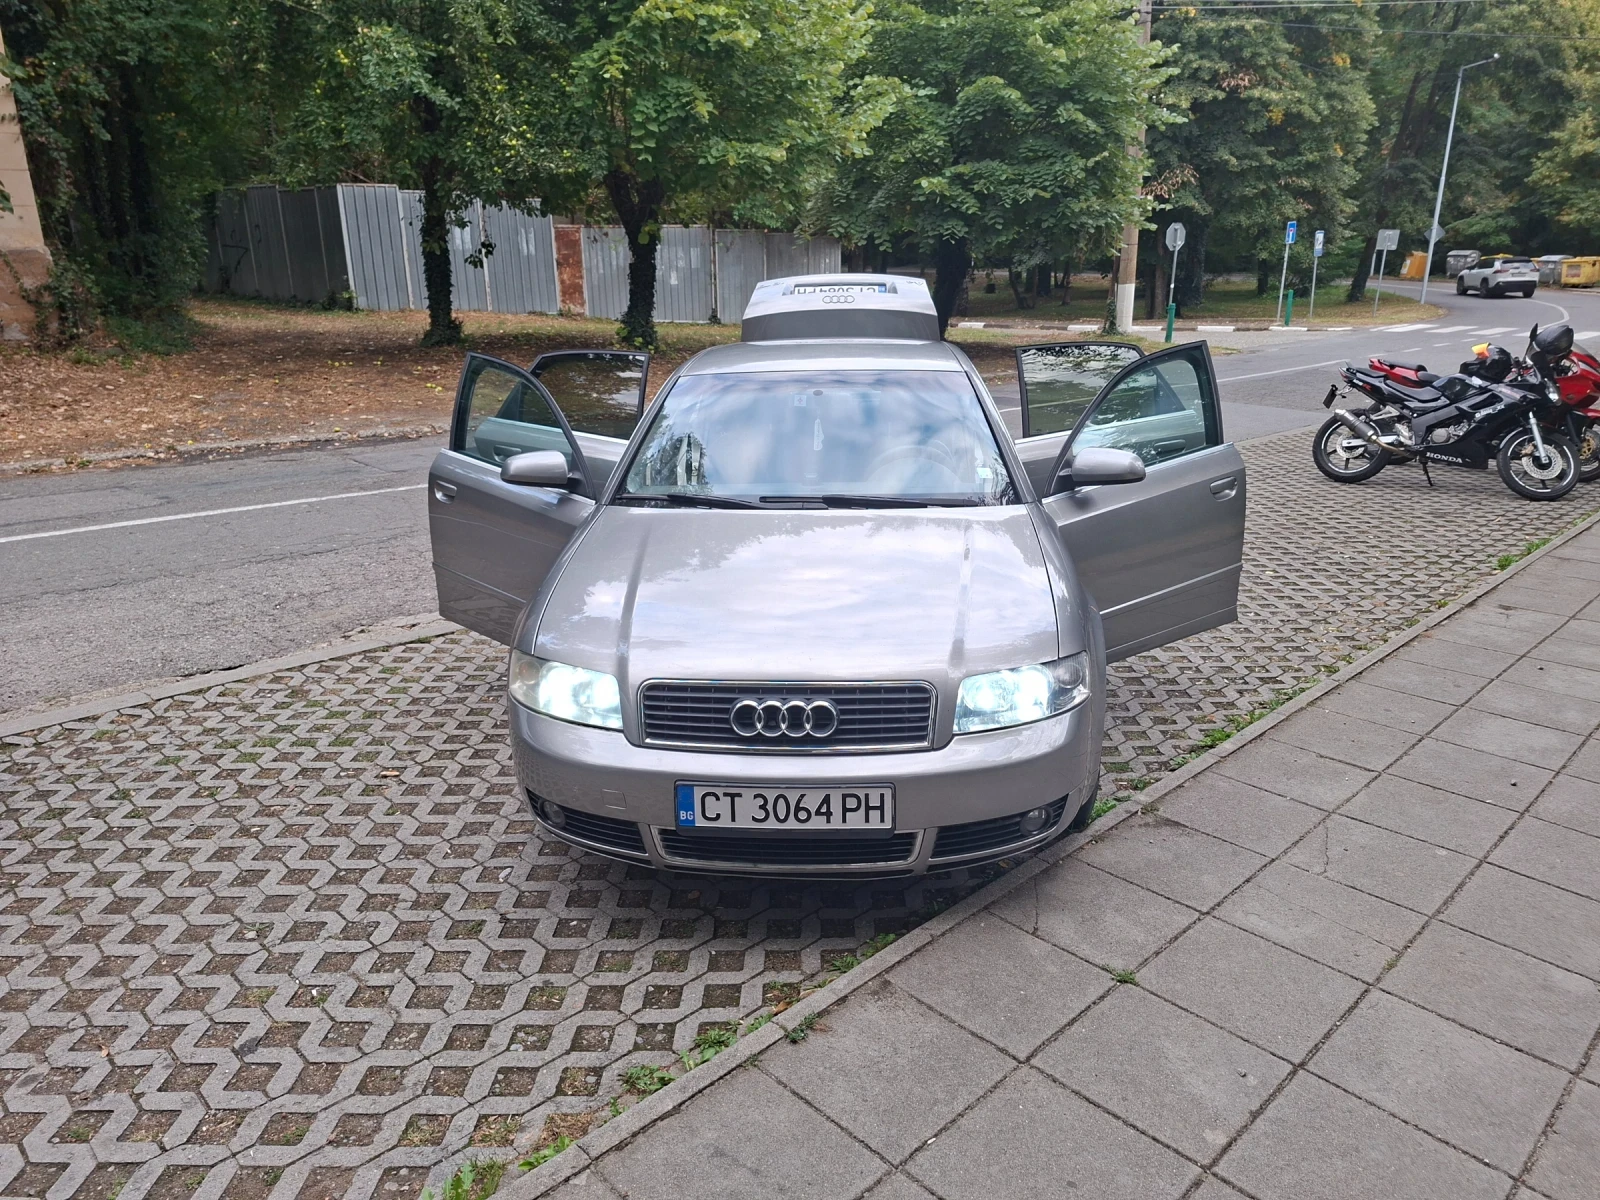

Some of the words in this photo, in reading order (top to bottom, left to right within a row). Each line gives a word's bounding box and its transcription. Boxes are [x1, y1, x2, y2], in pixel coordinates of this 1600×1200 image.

[1425, 451, 1463, 464] HONDA
[700, 791, 743, 823] CT
[751, 792, 834, 824] 3064
[841, 792, 885, 824] PH
[680, 810, 694, 820] BG
